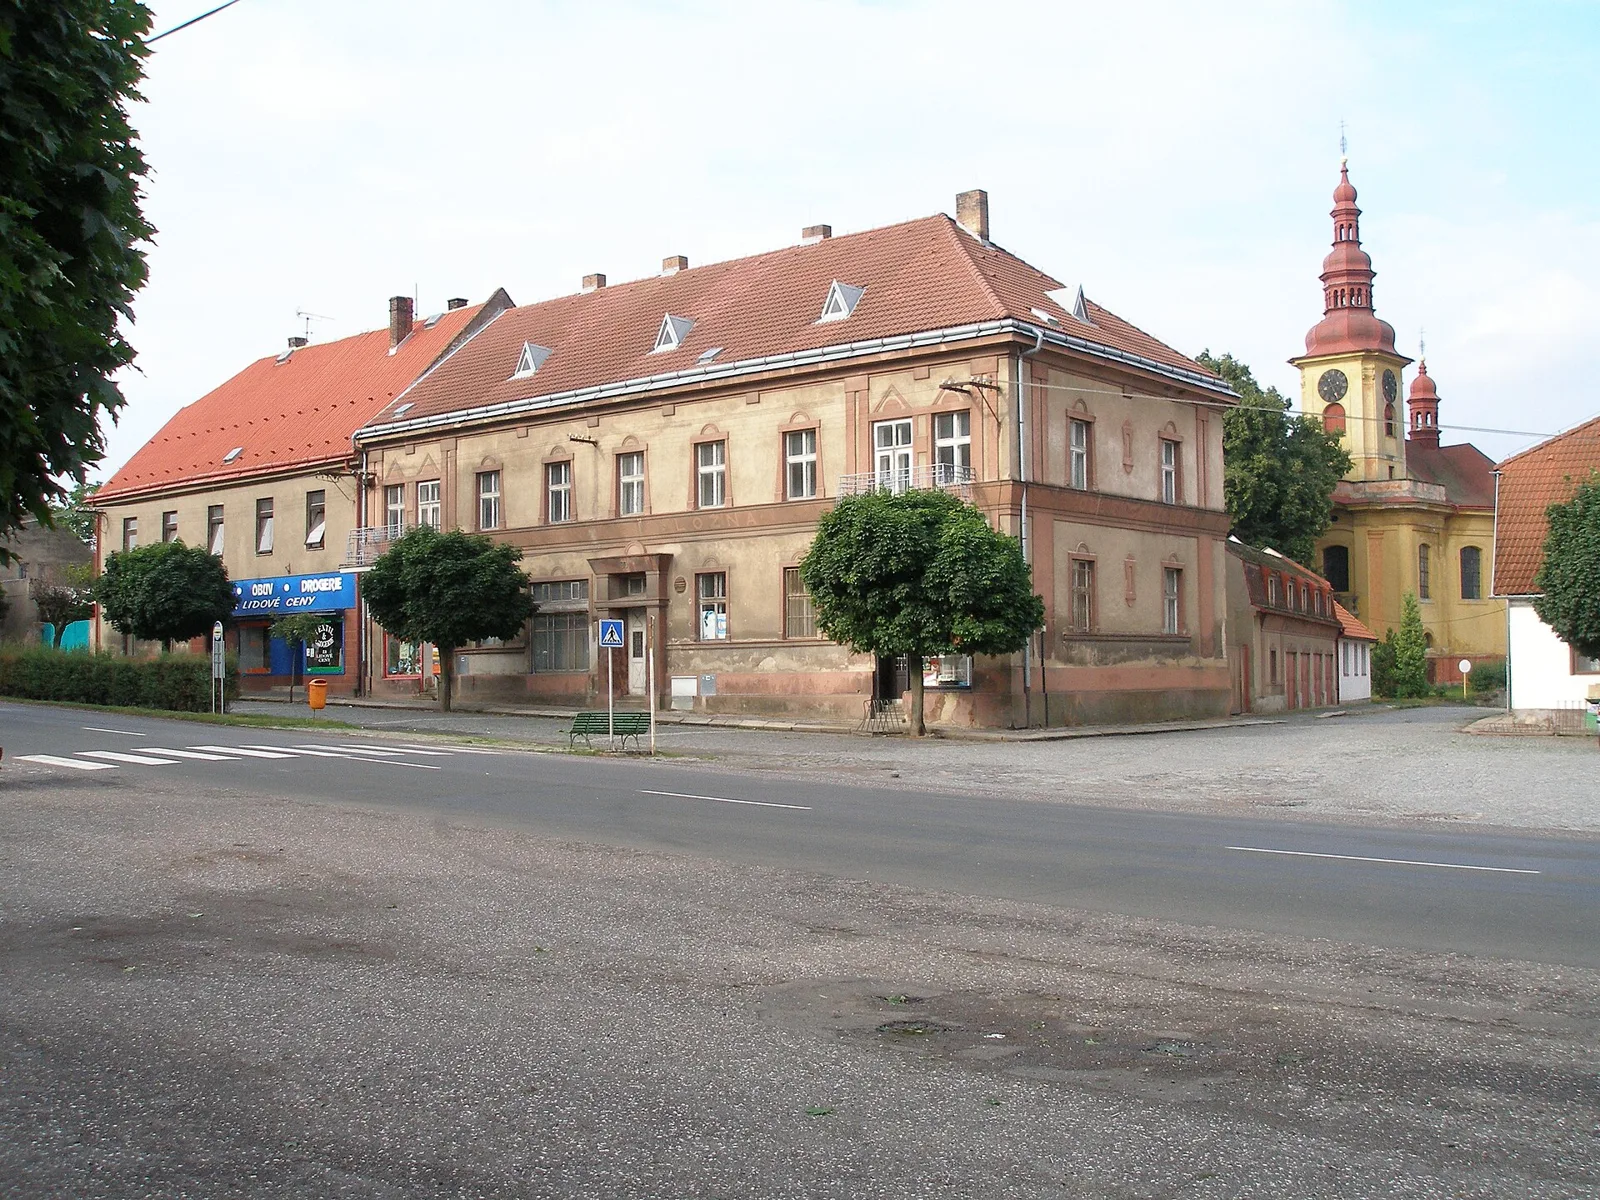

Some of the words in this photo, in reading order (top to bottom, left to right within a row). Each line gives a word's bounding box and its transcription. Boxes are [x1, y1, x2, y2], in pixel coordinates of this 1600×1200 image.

[252, 583, 274, 596] OBUV
[301, 577, 342, 592] DROGERIE
[242, 597, 280, 609] LIDOVÉ
[286, 596, 316, 607] CENY
